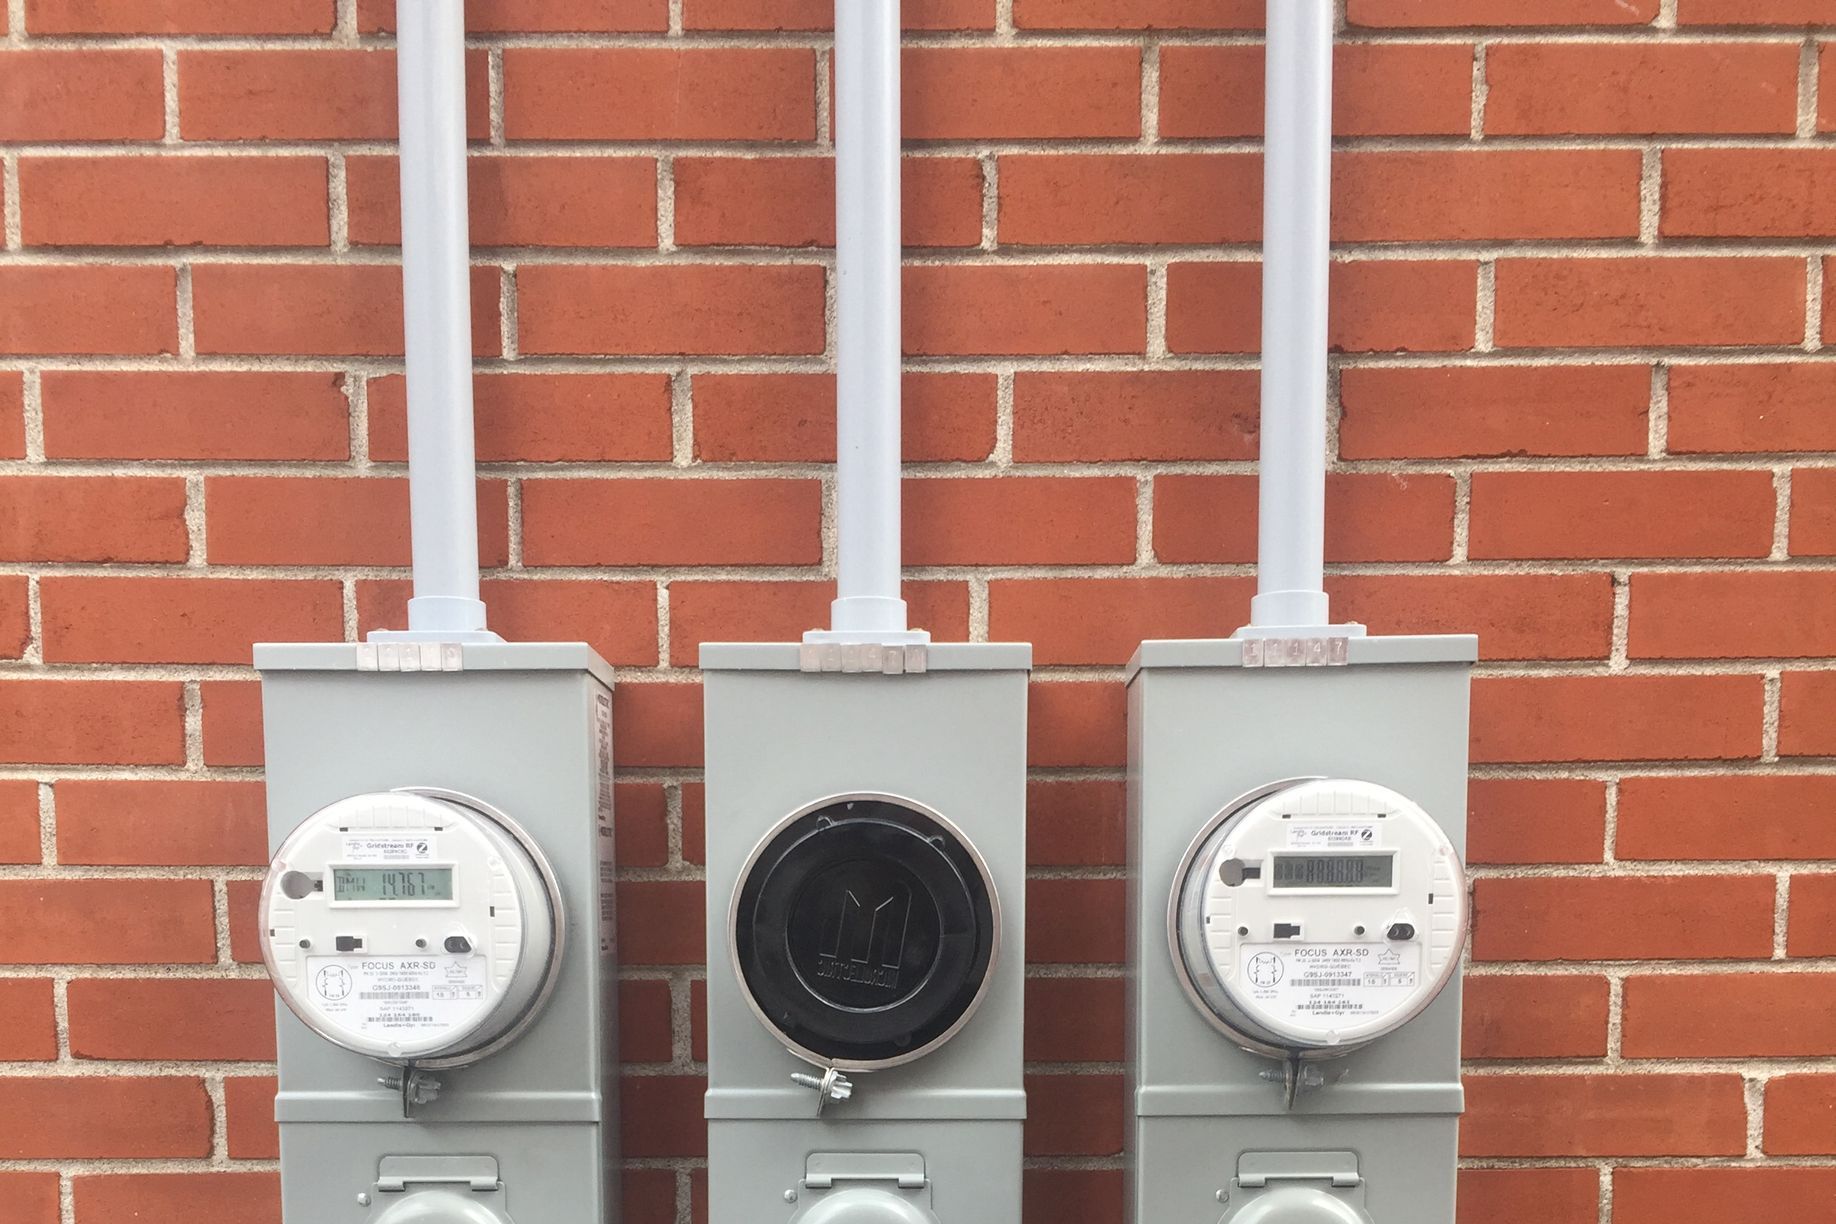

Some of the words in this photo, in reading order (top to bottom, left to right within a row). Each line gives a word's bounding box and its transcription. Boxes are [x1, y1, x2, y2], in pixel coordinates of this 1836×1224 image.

[1294, 949, 1327, 957] FOCUS
[1333, 949, 1369, 957] AXR-SD
[362, 962, 394, 970] FOCUS
[400, 962, 436, 970] AXR-SD
